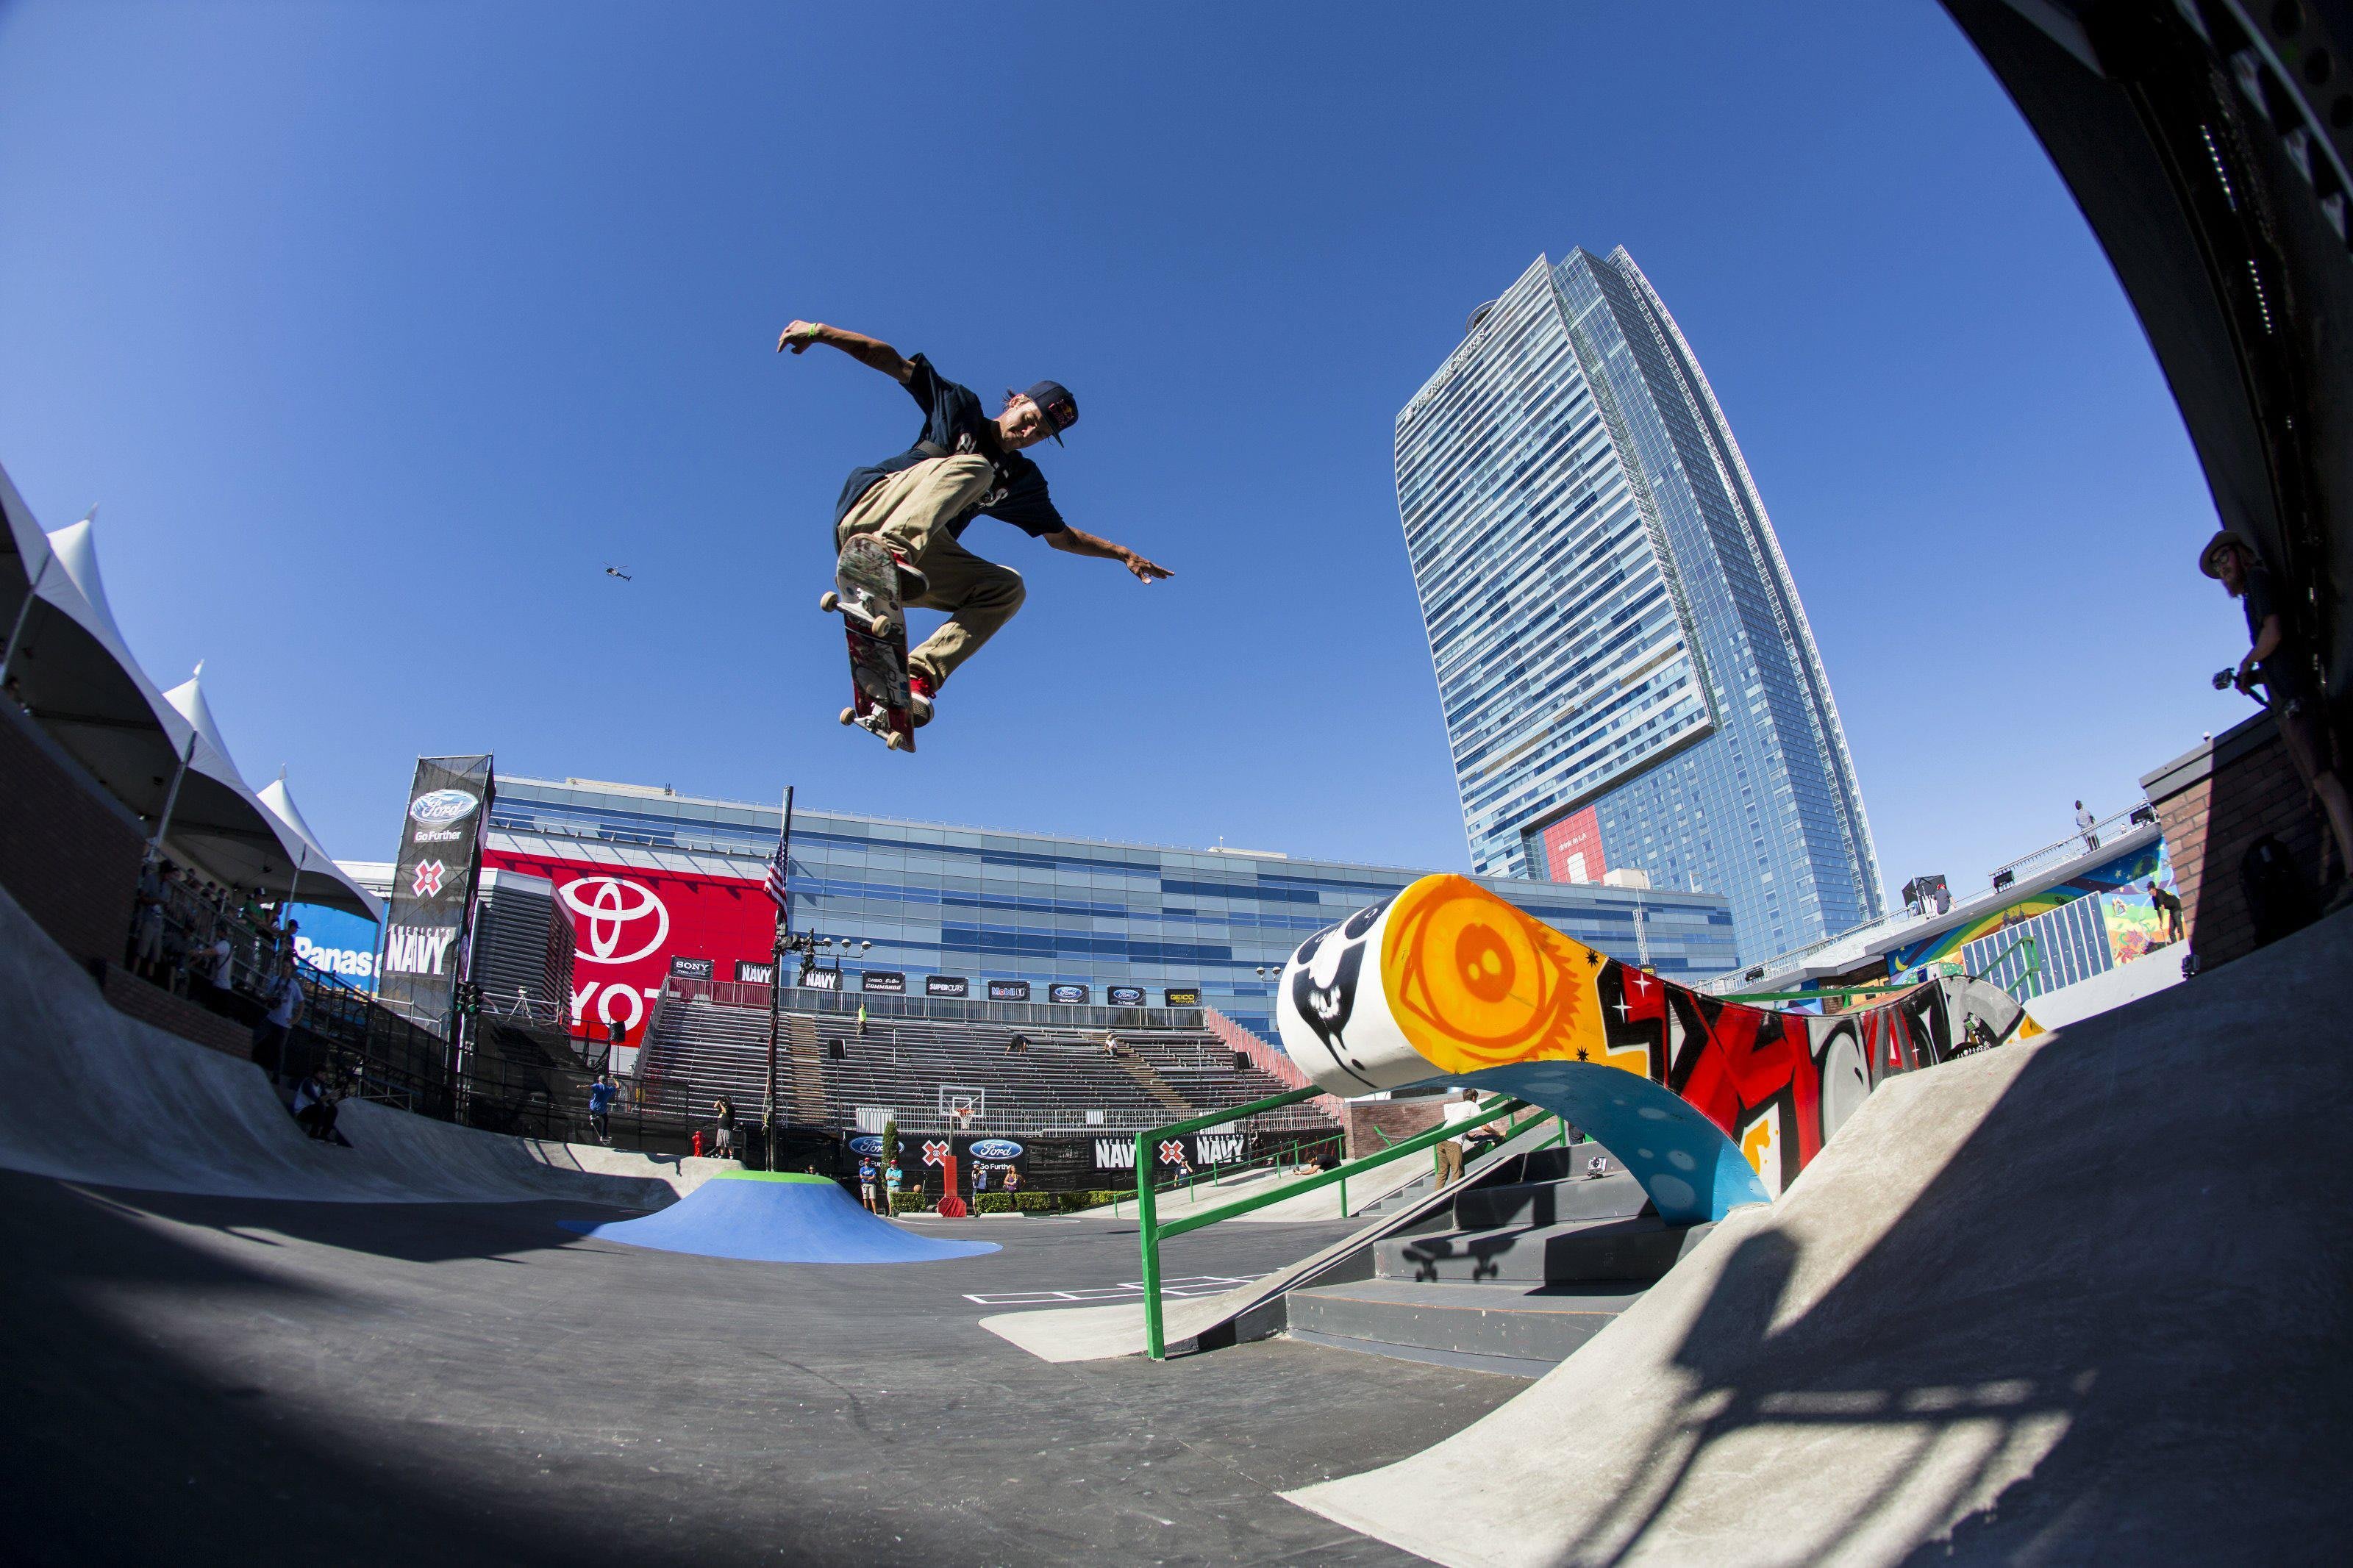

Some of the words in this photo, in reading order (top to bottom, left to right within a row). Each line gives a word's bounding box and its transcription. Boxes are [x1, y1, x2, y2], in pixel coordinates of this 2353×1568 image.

[421, 795, 464, 817] Ford
[415, 831, 428, 842] Go
[429, 831, 462, 841] Further
[1559, 840, 1573, 851] drink
[1578, 833, 1587, 841] LA
[386, 934, 450, 975] NAVY
[676, 961, 710, 971] SONY
[742, 967, 771, 984] NAVY
[806, 973, 836, 989] NAVY
[929, 983, 964, 992] SUPERCUTS
[991, 987, 1015, 995] Mobil
[860, 1139, 883, 1153] For
[980, 1142, 1012, 1156] Ford
[1197, 1139, 1244, 1164] NAVY
[1096, 1144, 1138, 1168] NAV
